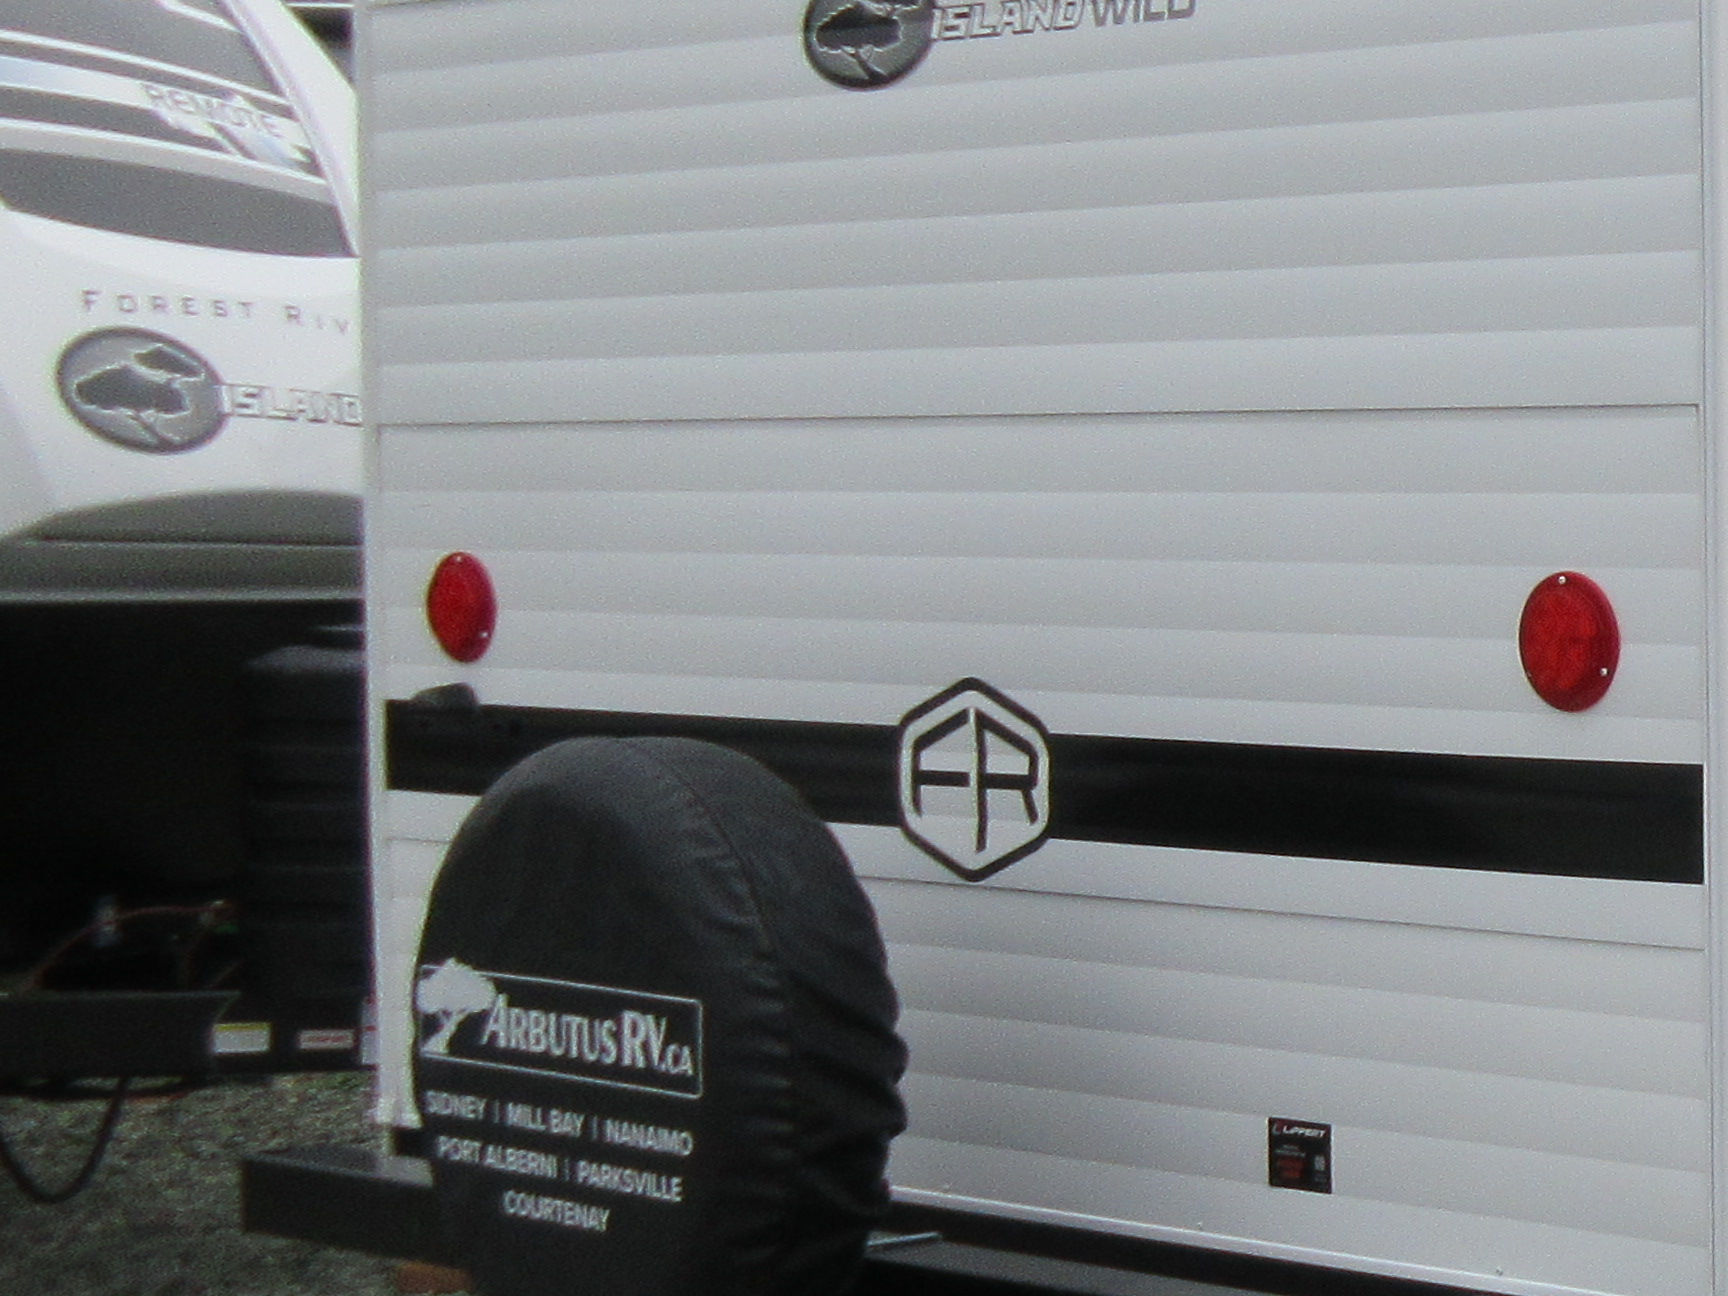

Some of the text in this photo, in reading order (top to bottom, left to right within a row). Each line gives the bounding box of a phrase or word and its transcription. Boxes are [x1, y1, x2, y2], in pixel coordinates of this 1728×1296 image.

[79, 289, 255, 320] FOREST
[423, 1090, 694, 1157] SIDNEY MILL BAY NANAIMO
[435, 1135, 684, 1203] PORT ALBERNI PARKSVILLE
[503, 1190, 611, 1233] COURTENAY
